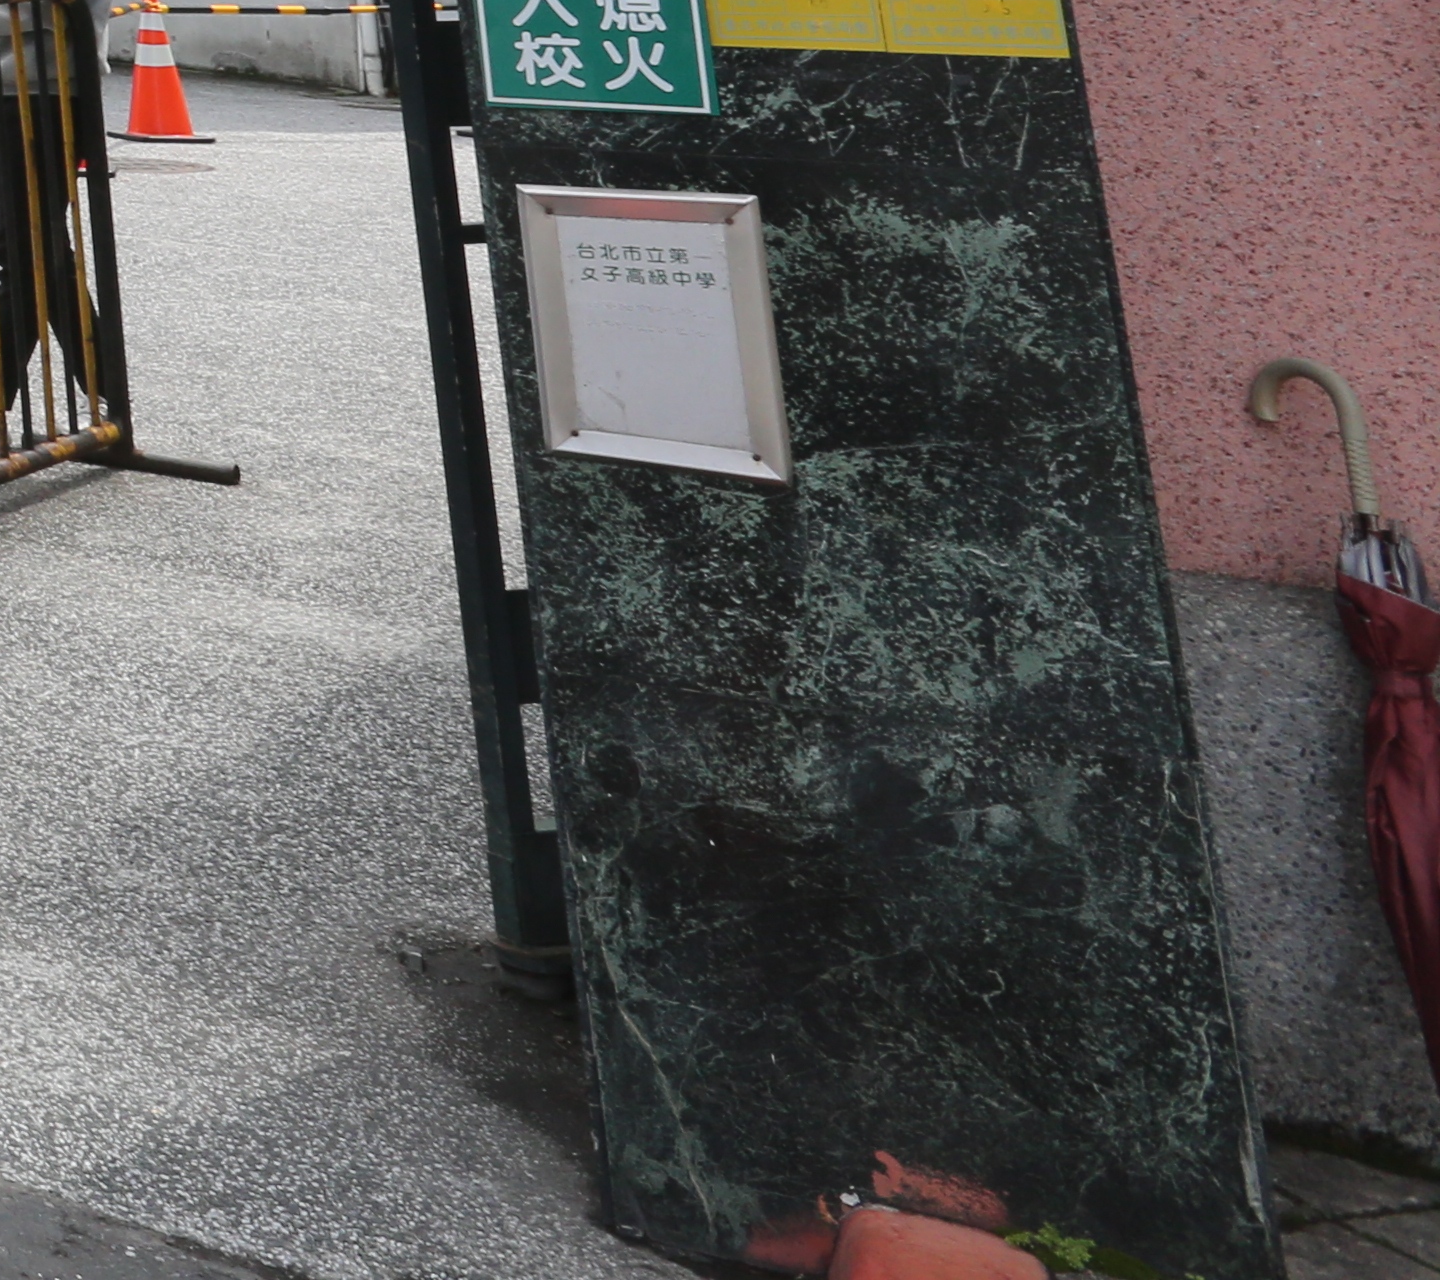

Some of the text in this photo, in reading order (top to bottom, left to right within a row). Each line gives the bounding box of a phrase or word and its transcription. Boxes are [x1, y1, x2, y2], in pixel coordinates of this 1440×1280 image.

[577, 243, 713, 265] 台北市立第一
[580, 265, 717, 289] 女子高級中學
